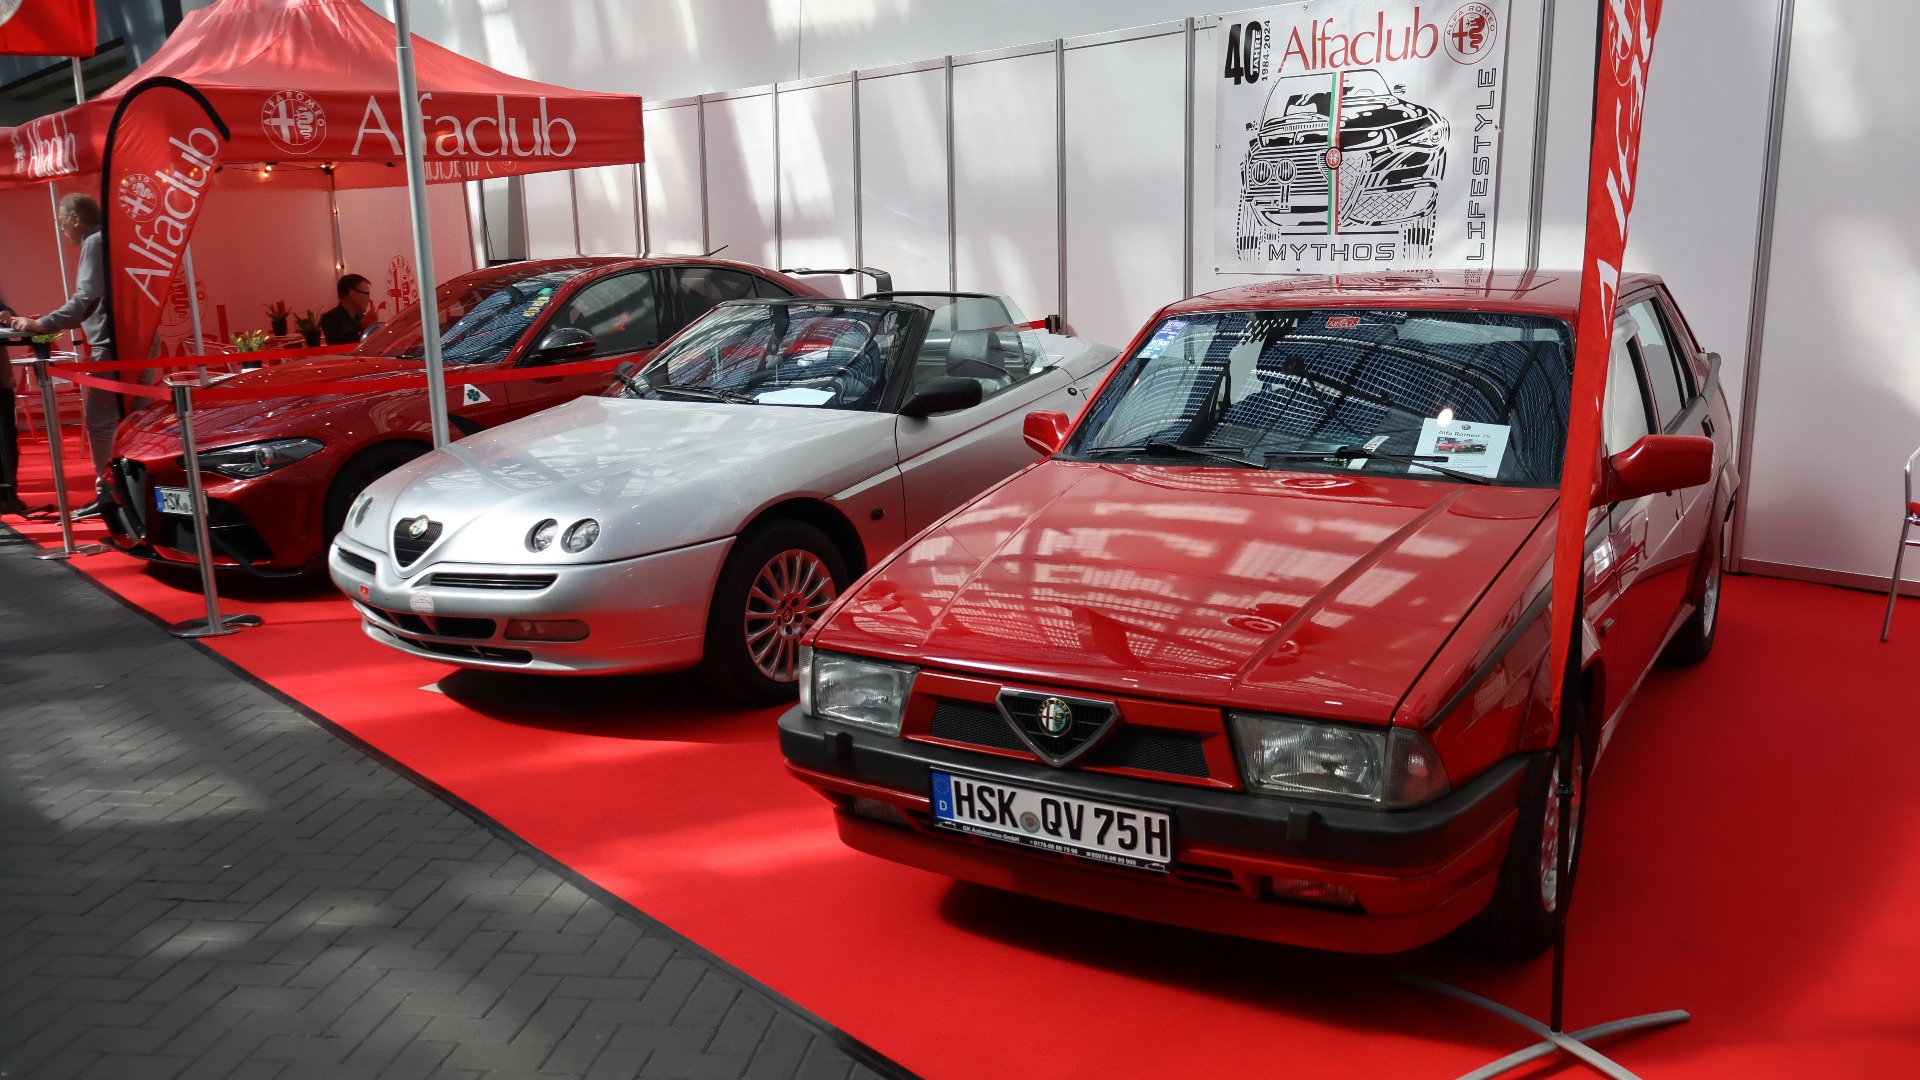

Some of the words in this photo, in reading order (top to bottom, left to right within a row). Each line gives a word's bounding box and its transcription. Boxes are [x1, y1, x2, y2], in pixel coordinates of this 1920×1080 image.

[1261, 19, 1271, 82] 1984-2024
[1277, 6, 1439, 74] Alfaclub
[1446, 10, 1464, 36] ALFA
[1468, 5, 1496, 32] ROMEO
[1224, 20, 1264, 86] 40
[1253, 29, 1262, 74] JAHRE
[263, 94, 284, 126] ALFA
[286, 91, 326, 127] ROMEO
[351, 92, 577, 157] Afaclub
[1466, 67, 1497, 261] LIFESTYLE
[124, 127, 220, 307] Alfaclub
[1268, 242, 1396, 261] MYTHOS
[939, 799, 948, 811] D
[954, 780, 1019, 829] HSK
[1040, 797, 1084, 841] QV
[971, 827, 1002, 839] Autoservice
[1003, 834, 1020, 842] GmbH
